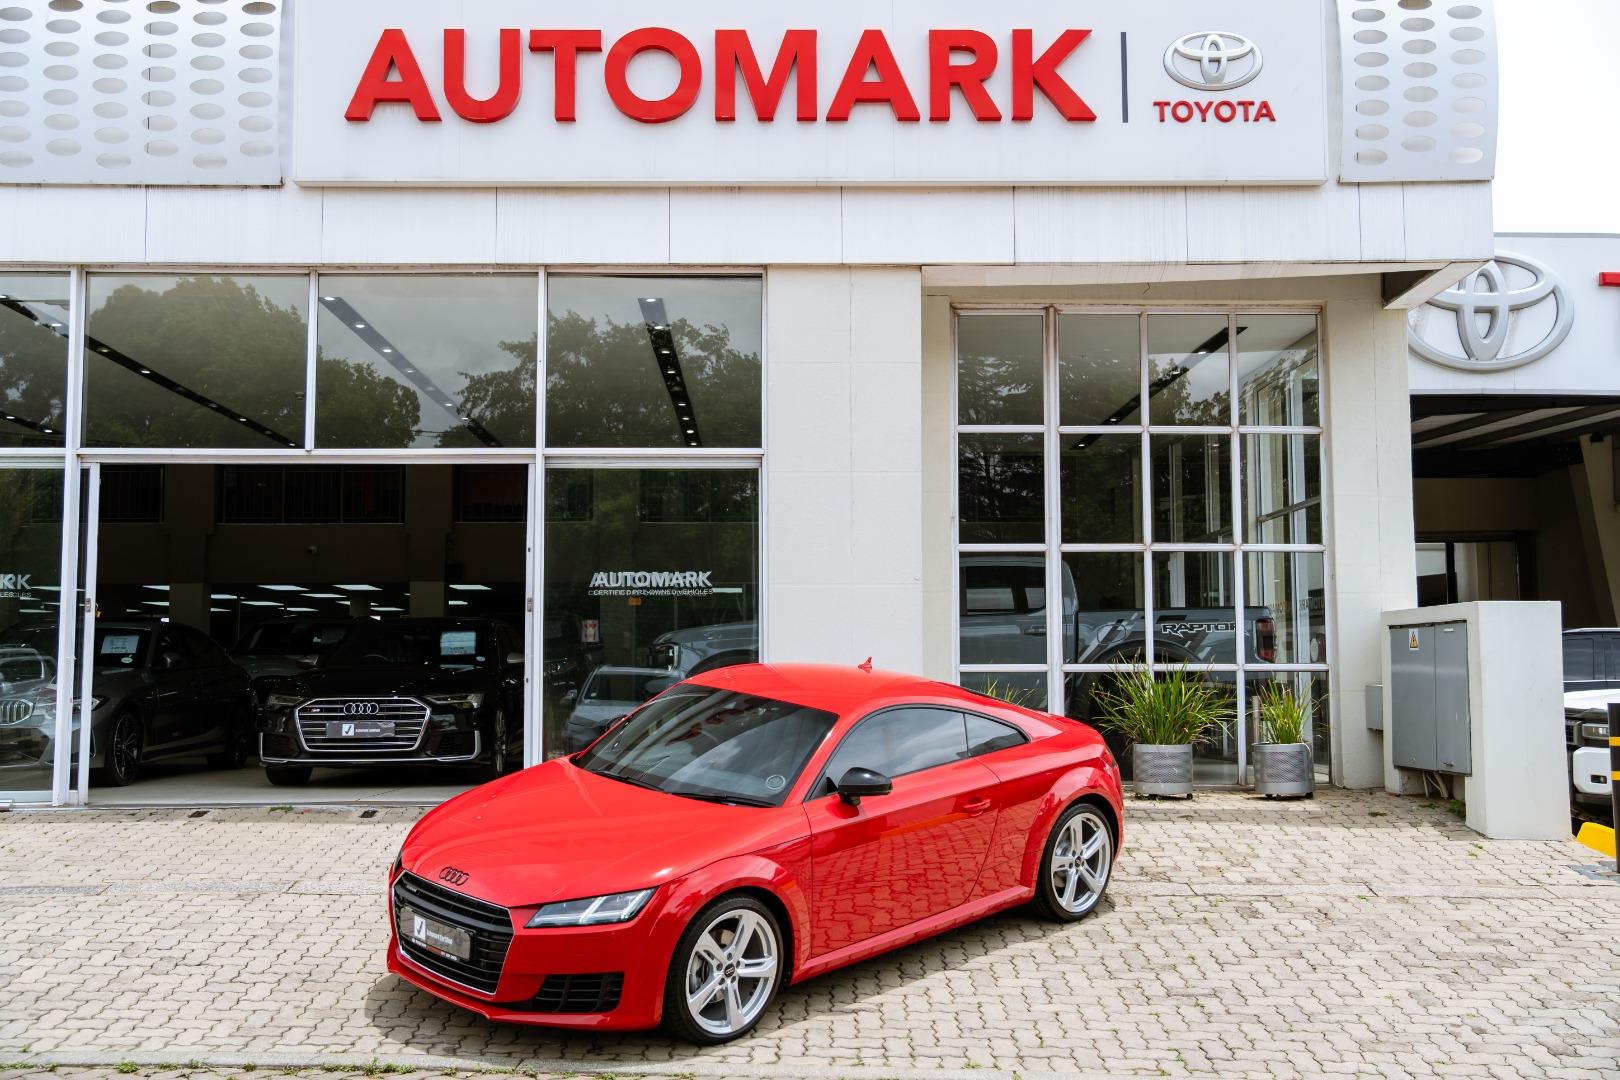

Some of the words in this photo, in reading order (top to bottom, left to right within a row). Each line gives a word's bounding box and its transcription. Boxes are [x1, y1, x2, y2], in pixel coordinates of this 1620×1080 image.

[344, 27, 1097, 123] AUTOMARK
[1153, 100, 1276, 123] TOYOTA
[588, 571, 713, 588] AUTOMARK
